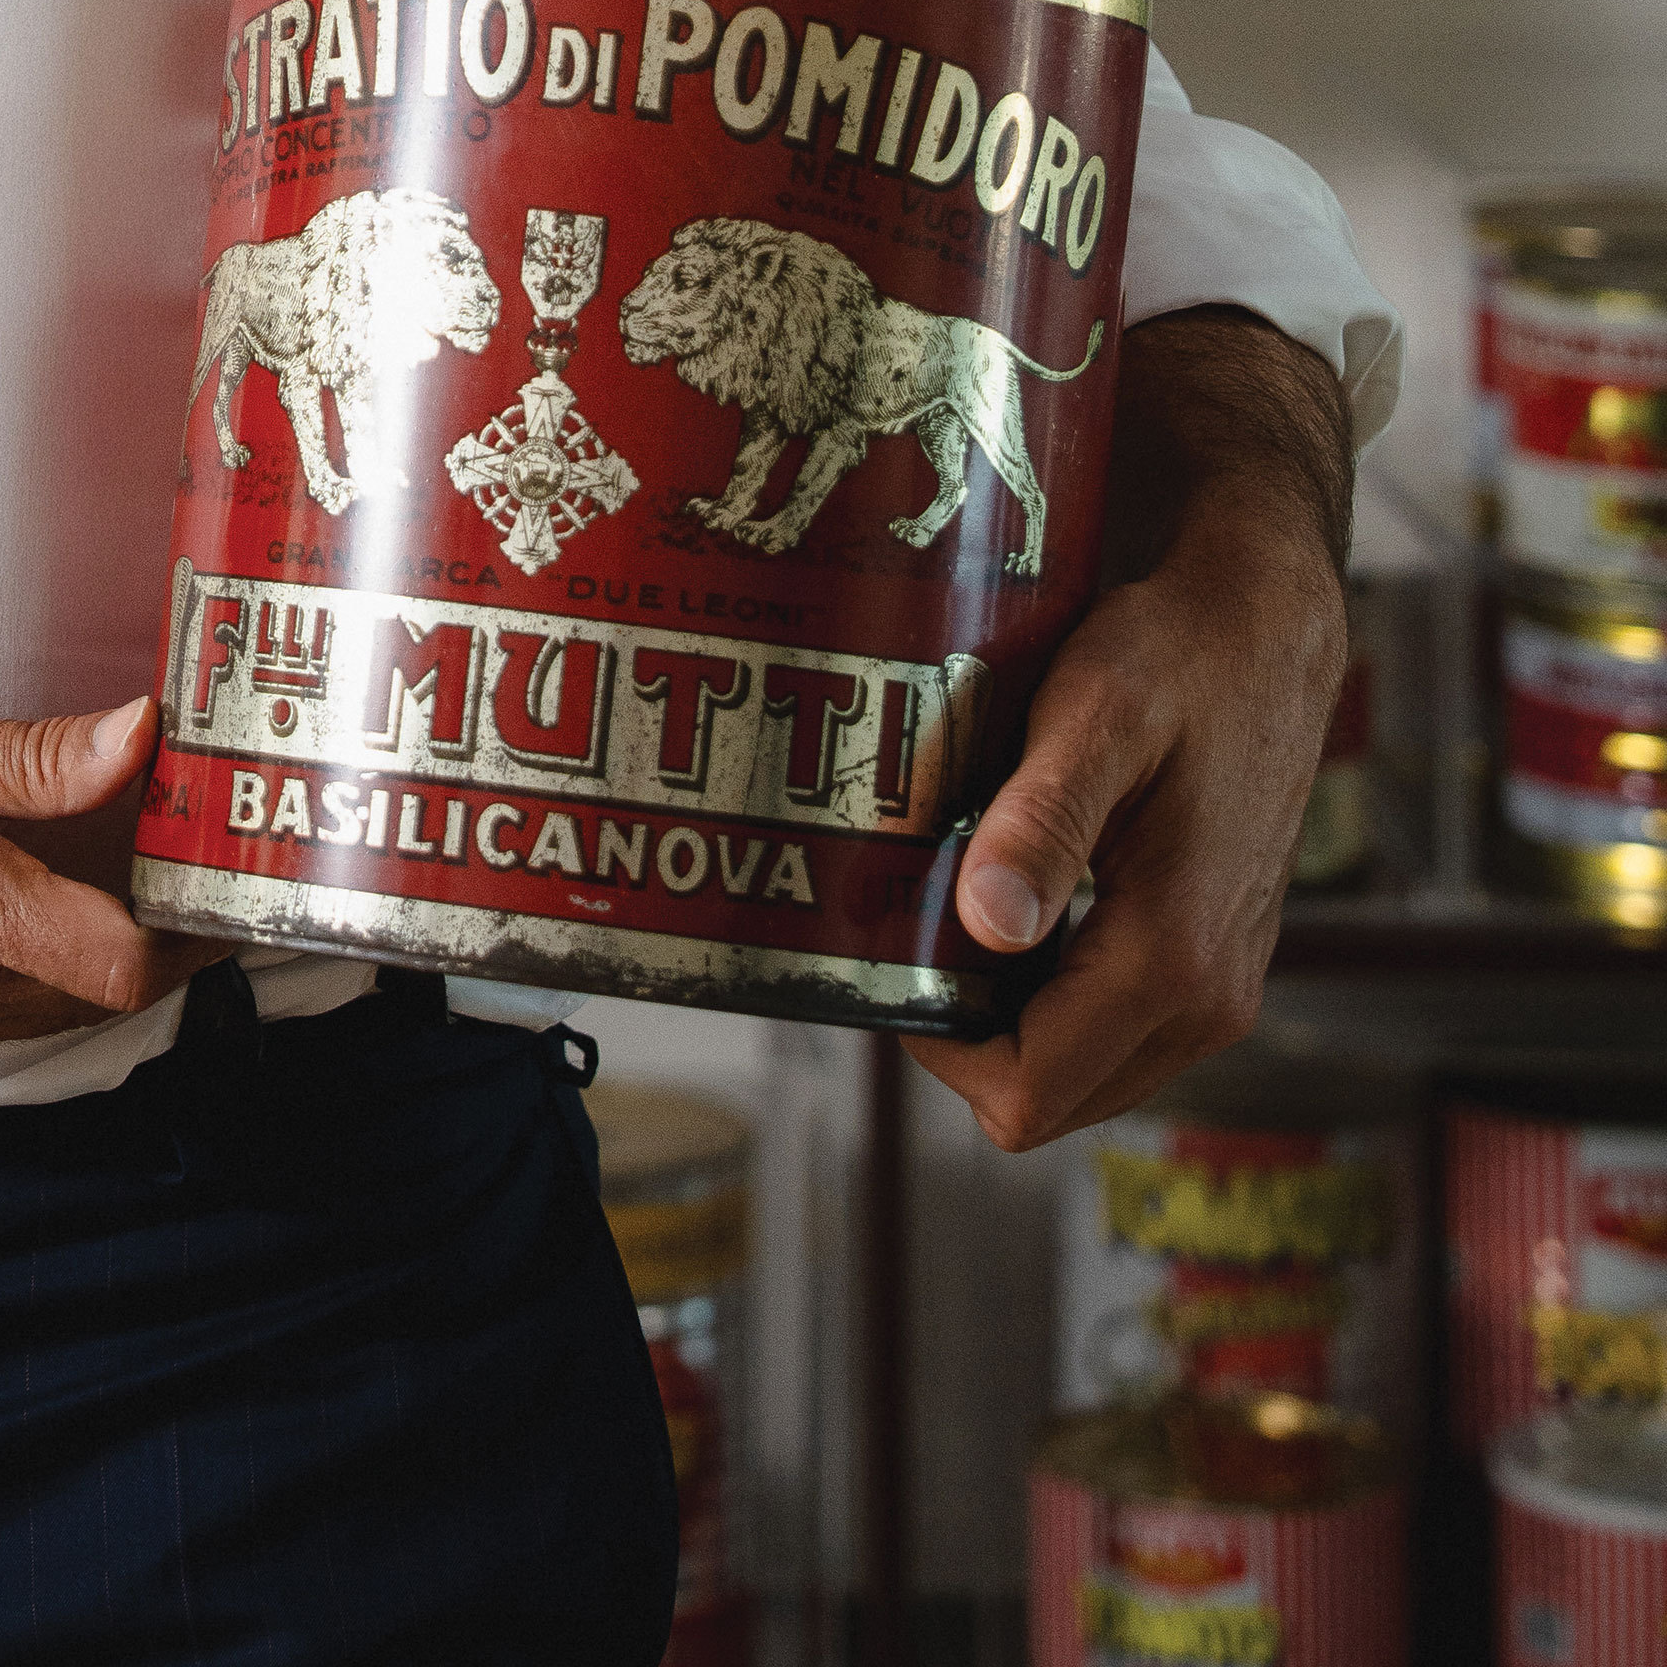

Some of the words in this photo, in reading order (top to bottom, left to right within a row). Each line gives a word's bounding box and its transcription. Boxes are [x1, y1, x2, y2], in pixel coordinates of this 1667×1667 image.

[541, 23, 618, 110] DI
[399, 555, 502, 590] ARCA
[361, 615, 918, 817] MUTTI
[227, 768, 817, 905] BASILICANOVA
